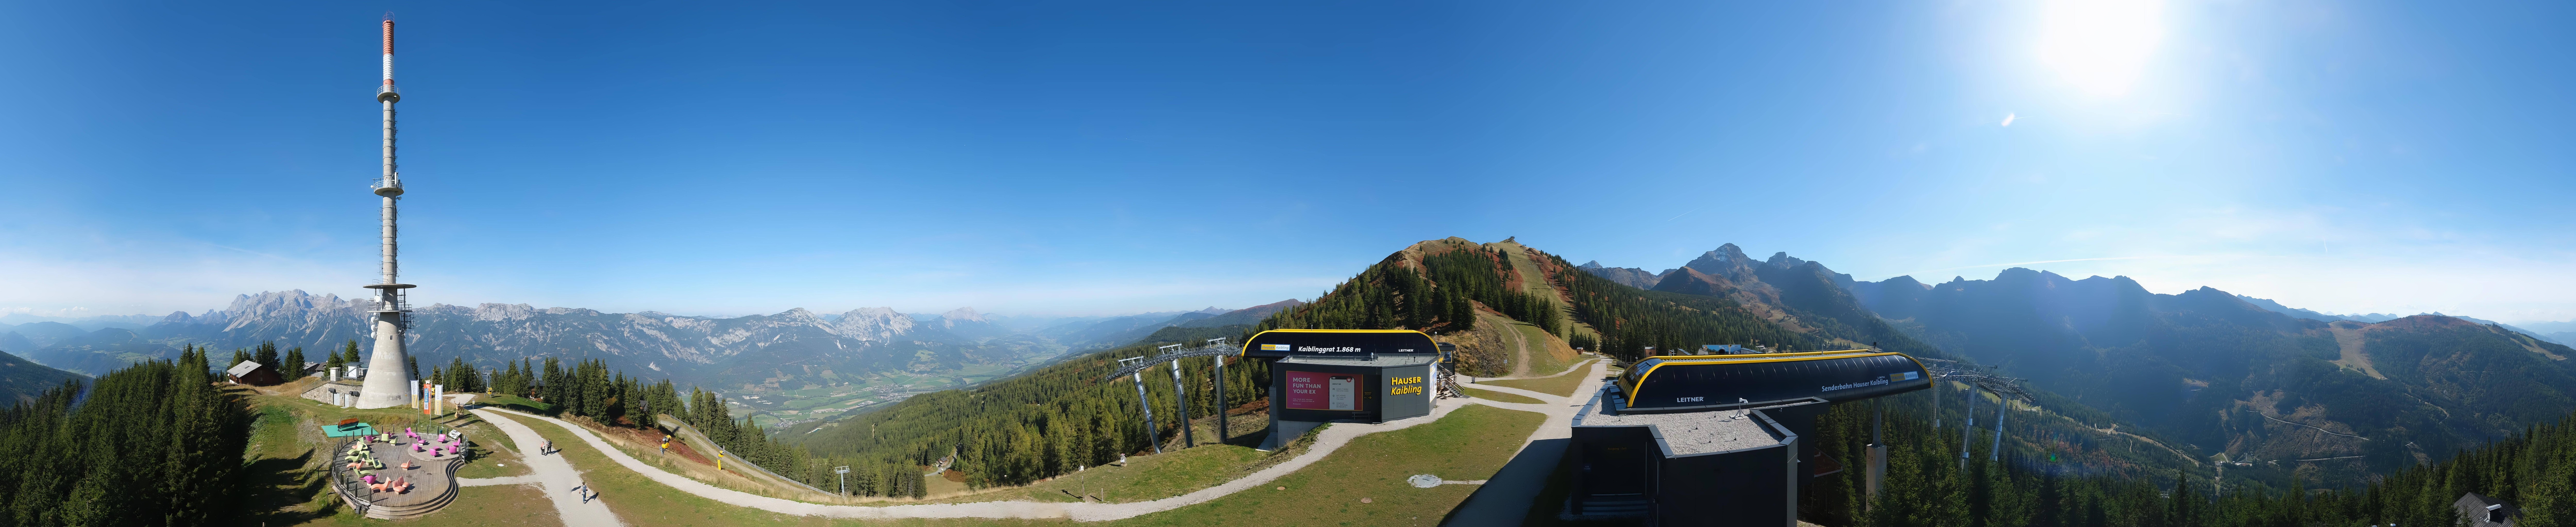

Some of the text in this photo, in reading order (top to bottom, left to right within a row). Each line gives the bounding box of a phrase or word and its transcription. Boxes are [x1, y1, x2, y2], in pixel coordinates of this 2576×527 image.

[1391, 377, 1421, 385] HAUSER
[1391, 385, 1422, 395] Kaibling
[1822, 383, 1852, 392] Senderbahn
